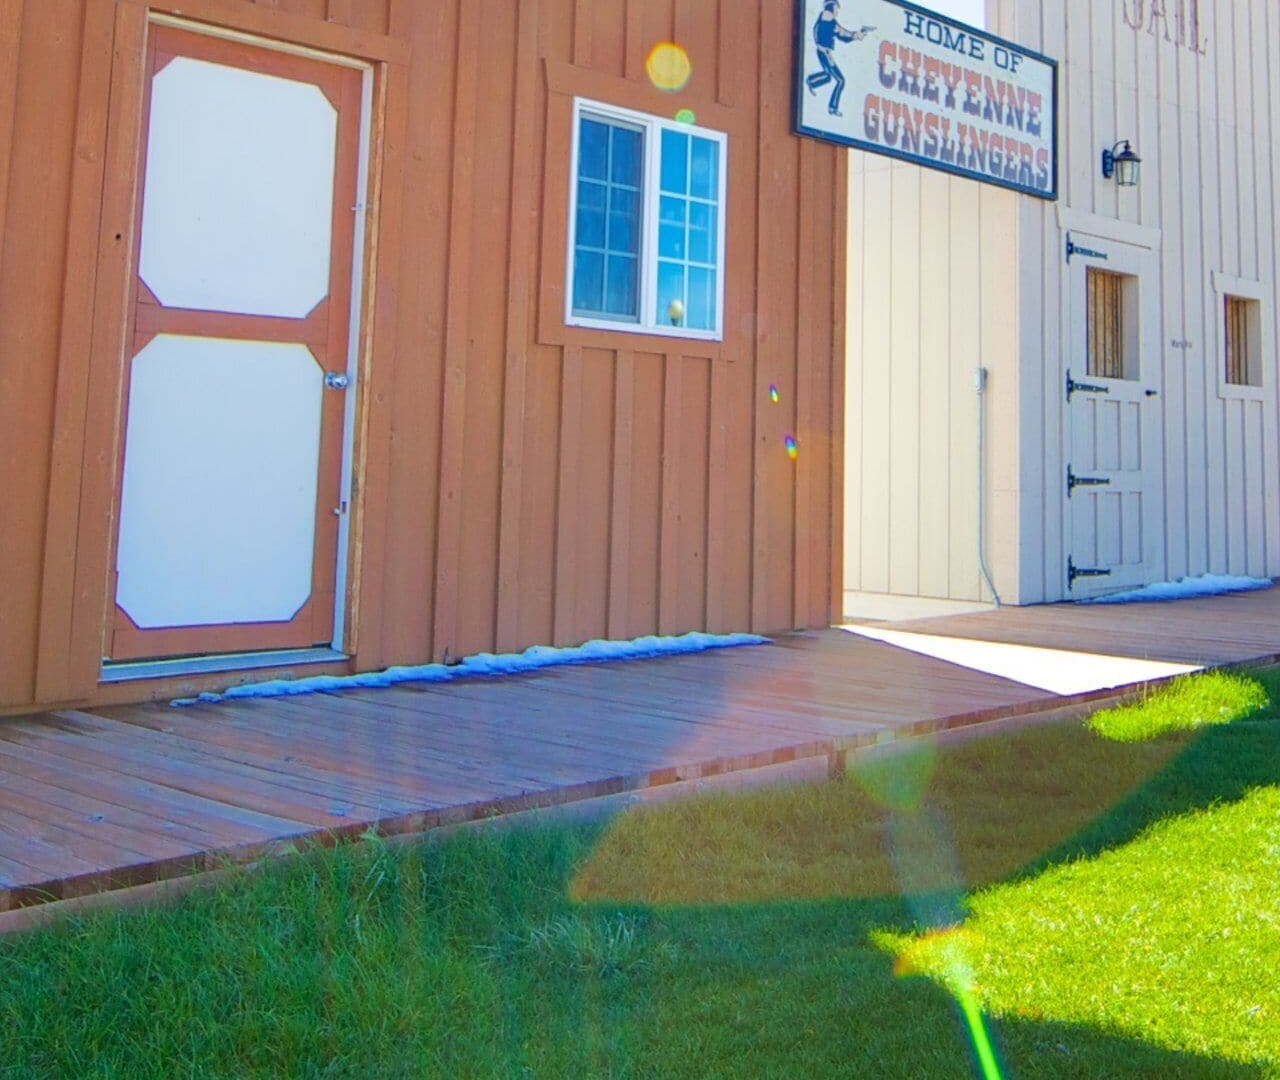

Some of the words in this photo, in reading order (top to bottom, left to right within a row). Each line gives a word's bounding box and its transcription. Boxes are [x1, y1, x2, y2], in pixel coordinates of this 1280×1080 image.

[878, 39, 1042, 138] CHEYENNE
[903, 10, 985, 61] HOME
[993, 46, 1023, 73] OF
[863, 93, 1049, 191] GUNSLINGERS
